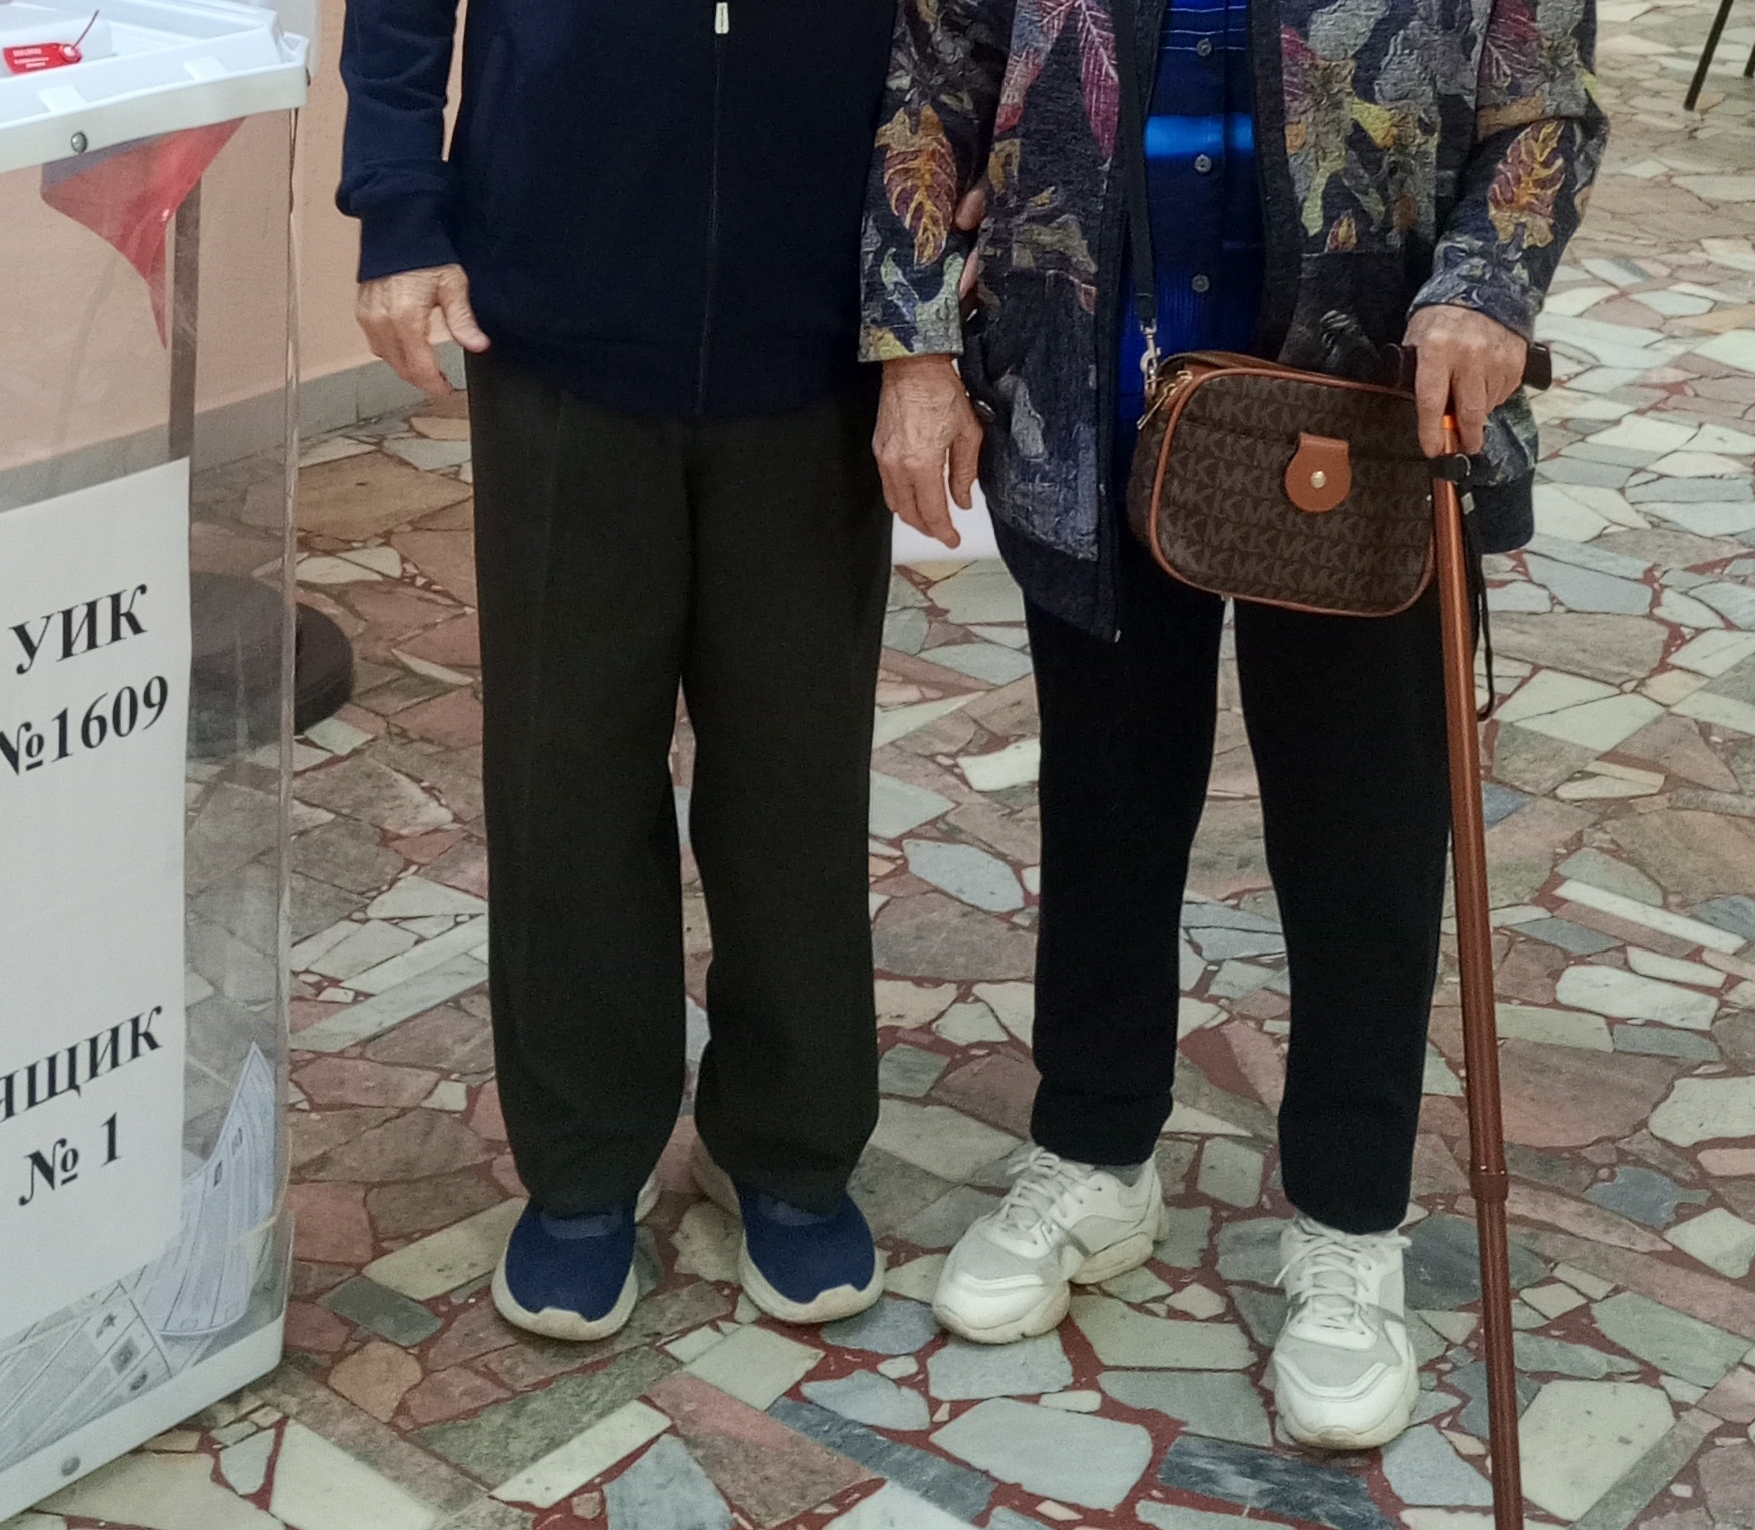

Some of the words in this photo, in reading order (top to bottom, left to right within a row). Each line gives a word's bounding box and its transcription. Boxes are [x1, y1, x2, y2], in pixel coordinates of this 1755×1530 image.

[8, 583, 149, 675] УИК
[0, 675, 169, 776] №1609
[18, 1137, 80, 1206] №
[101, 1111, 122, 1168] 1
